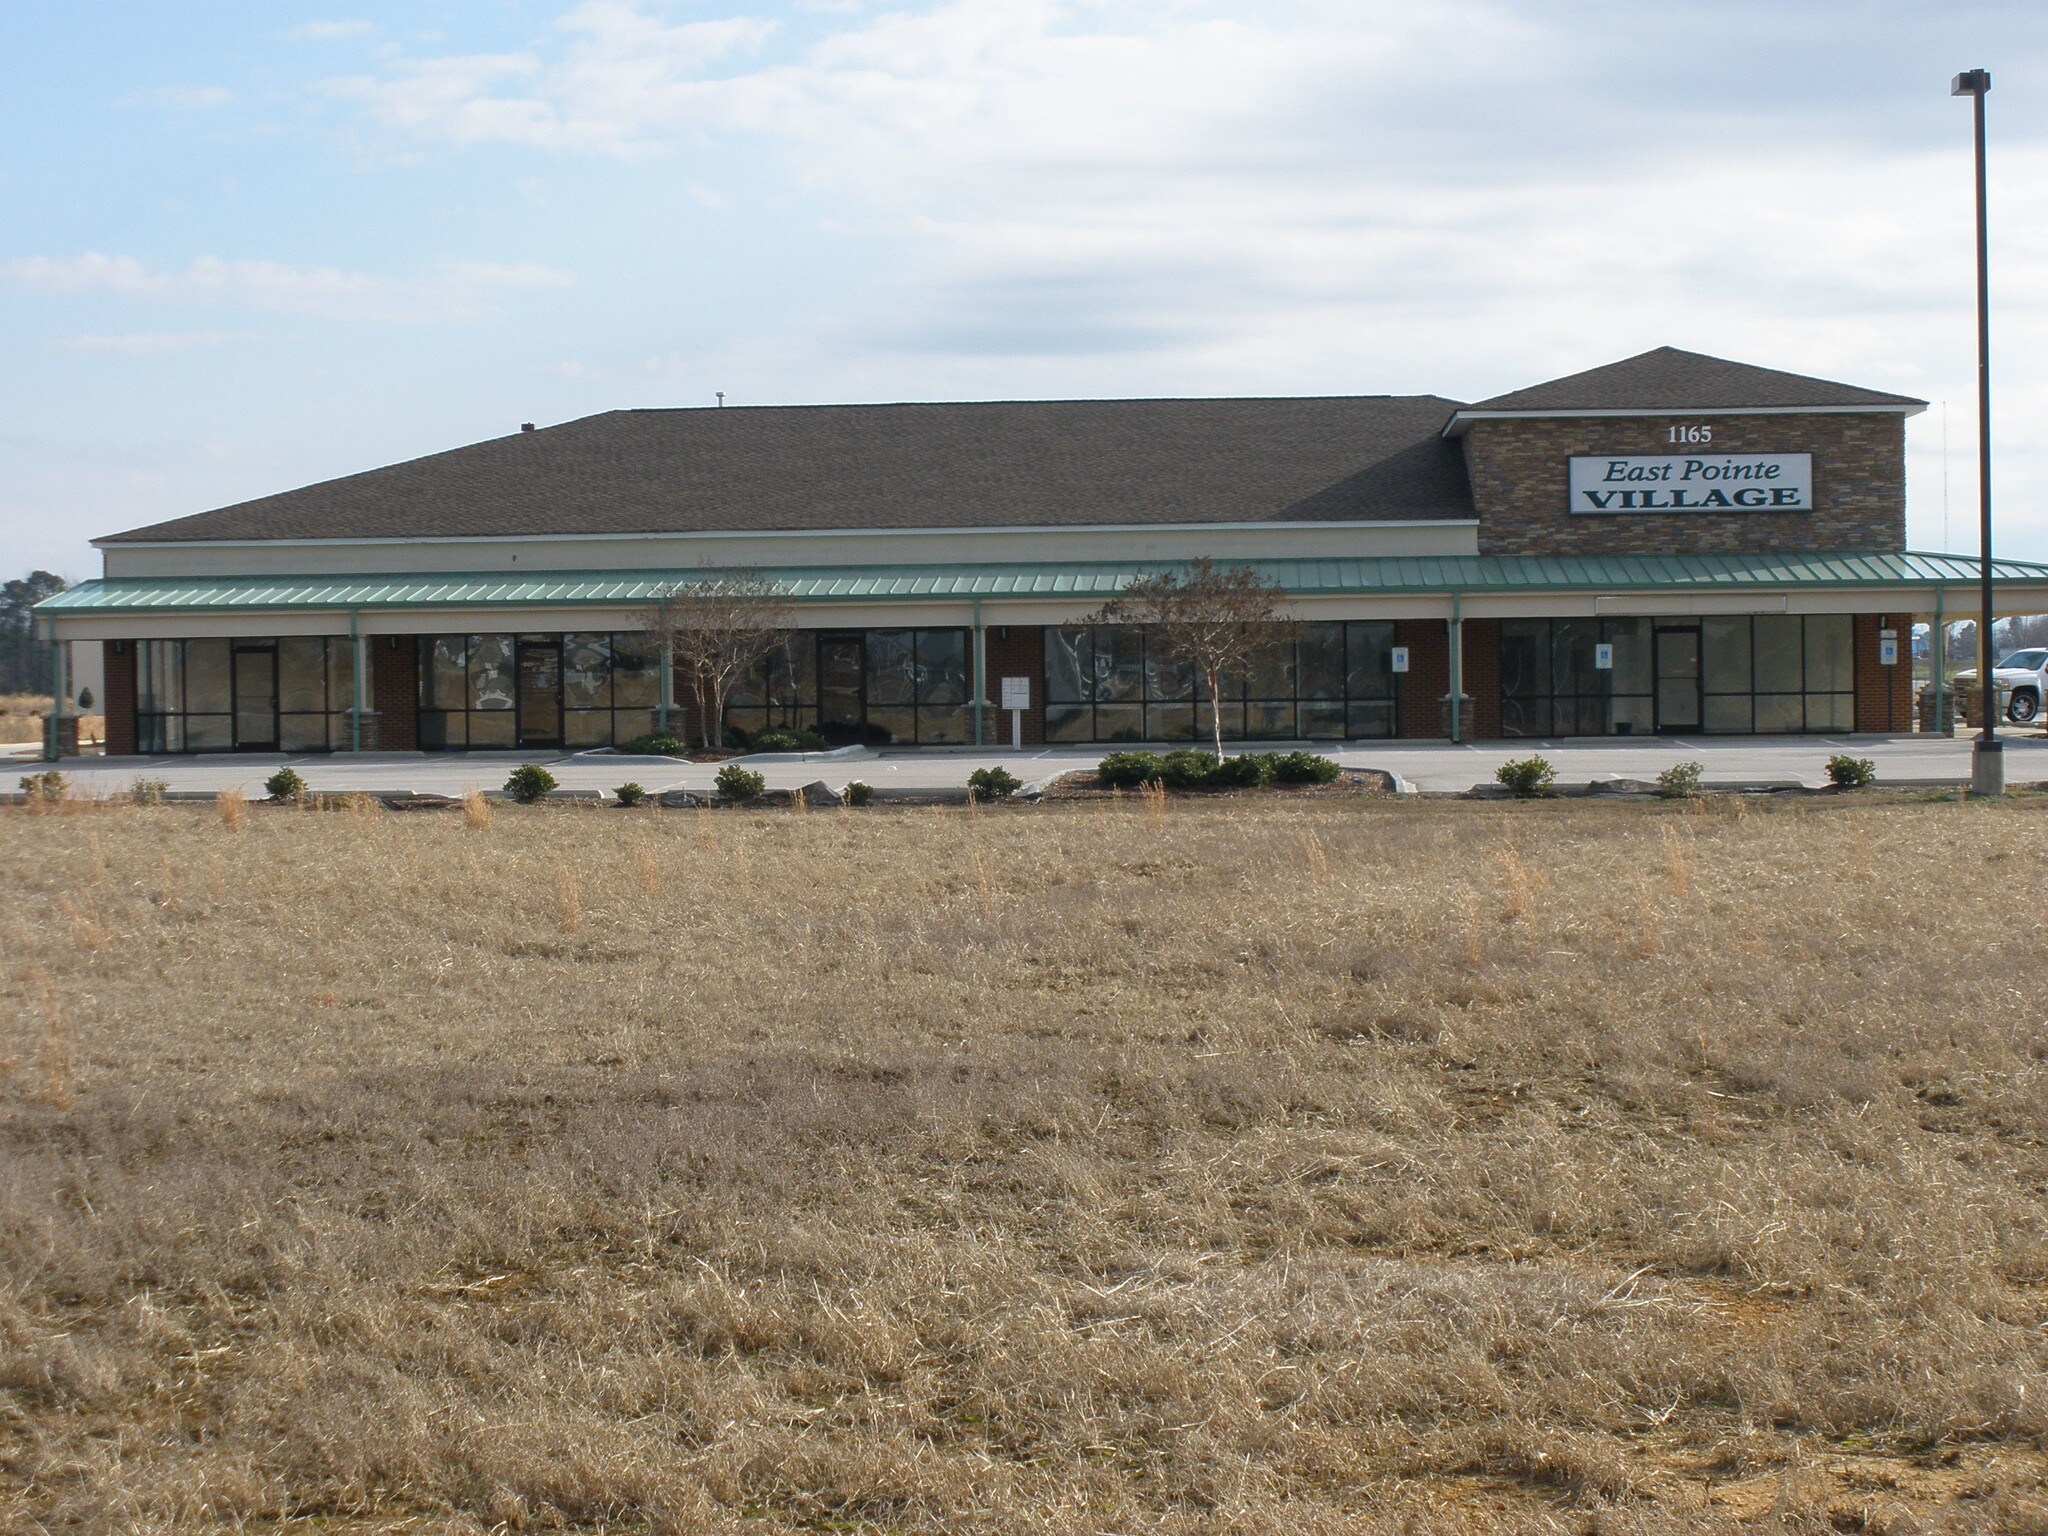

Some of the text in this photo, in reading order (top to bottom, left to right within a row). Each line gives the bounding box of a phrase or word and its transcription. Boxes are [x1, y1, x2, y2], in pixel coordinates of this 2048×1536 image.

[1667, 425, 1713, 443] 1165
[1602, 459, 1781, 482] East Pointe
[1582, 487, 1802, 509] VILLAGE
